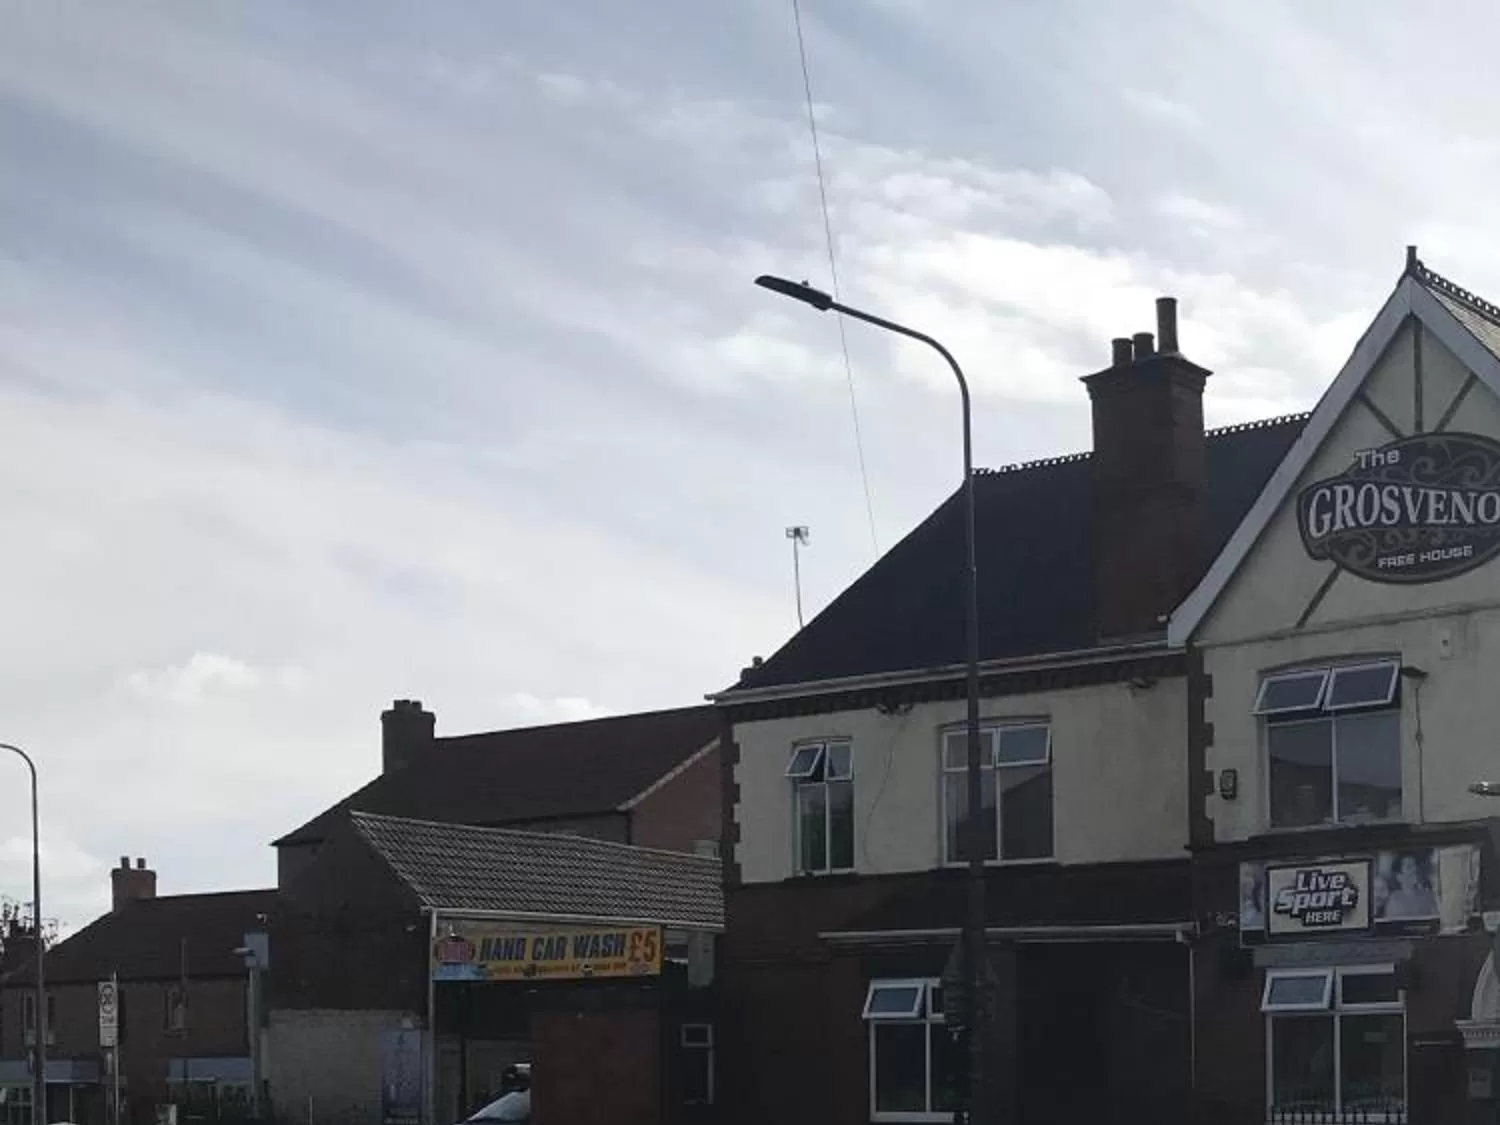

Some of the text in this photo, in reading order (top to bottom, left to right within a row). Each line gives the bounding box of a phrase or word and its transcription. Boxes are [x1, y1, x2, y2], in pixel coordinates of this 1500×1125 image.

[1353, 449, 1400, 470] The
[1377, 545, 1473, 568] FREE HOUSE
[1297, 872, 1346, 891] Live
[1276, 887, 1356, 915] Sport
[1305, 910, 1341, 924] HERE
[479, 930, 658, 962] HAND CAR WASH £5
